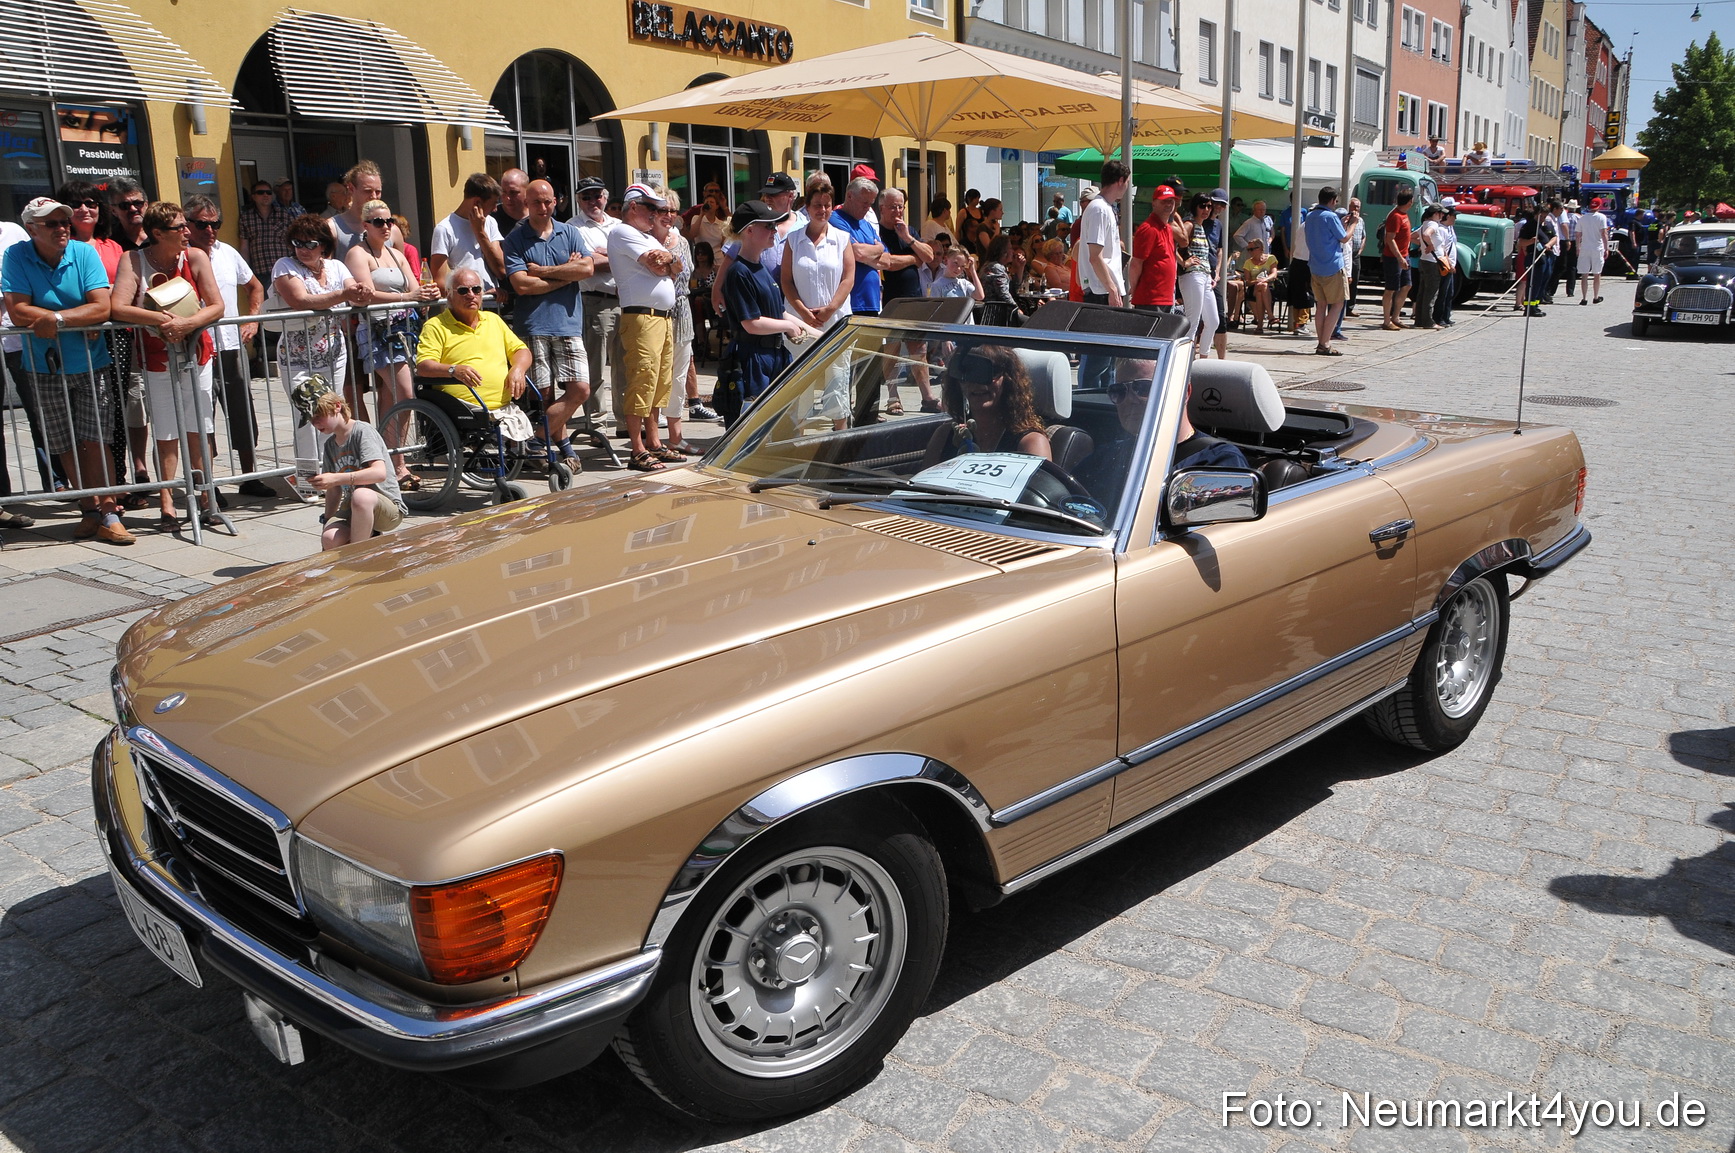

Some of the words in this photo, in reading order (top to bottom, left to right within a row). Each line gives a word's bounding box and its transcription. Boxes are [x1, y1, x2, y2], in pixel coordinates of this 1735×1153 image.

[633, 0, 794, 63] BELACCANTO
[720, 73, 890, 97] BELACCANTO
[79, 148, 124, 160] Passbilder
[66, 164, 140, 177] Bewerbungsbilder
[948, 164, 956, 176] 24
[962, 462, 1006, 478] 325
